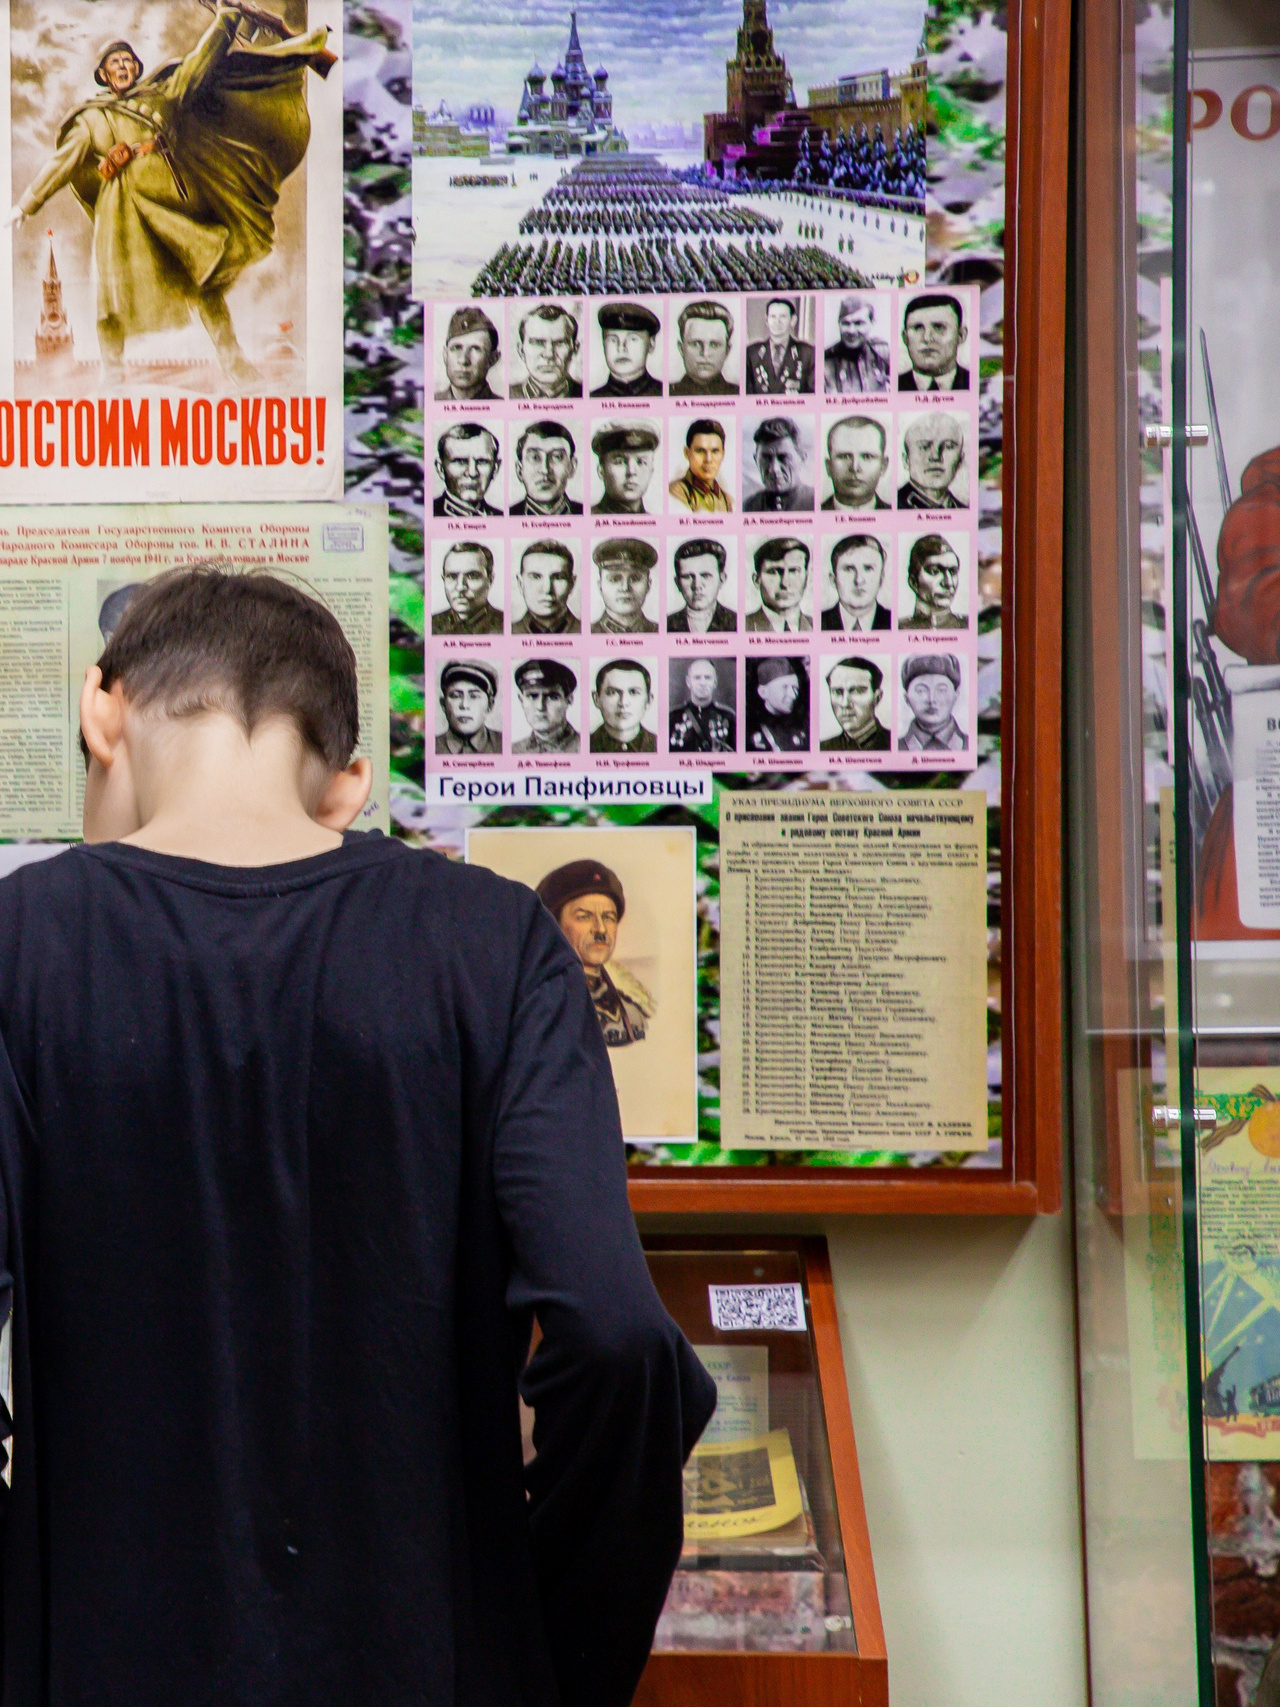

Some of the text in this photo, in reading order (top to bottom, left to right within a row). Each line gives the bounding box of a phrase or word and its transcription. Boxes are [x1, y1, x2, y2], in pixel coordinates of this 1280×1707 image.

[160, 397, 327, 467] МОСКВУ!
[17, 526, 90, 538] Председателя
[98, 525, 195, 538] Государственного
[201, 524, 252, 535] Комитета
[259, 523, 310, 536] Обороны
[61, 540, 118, 551] Комиссара
[125, 540, 174, 550] Обороны
[238, 538, 310, 549] СТАЛИНА
[30, 555, 68, 567] Красной
[71, 554, 100, 567] Армии
[110, 555, 142, 566] ноября
[144, 554, 162, 564] 1941
[174, 556, 184, 564] на
[226, 556, 266, 565] площади
[276, 553, 310, 563] Москве
[438, 777, 705, 800] Герои Панфиловцы
